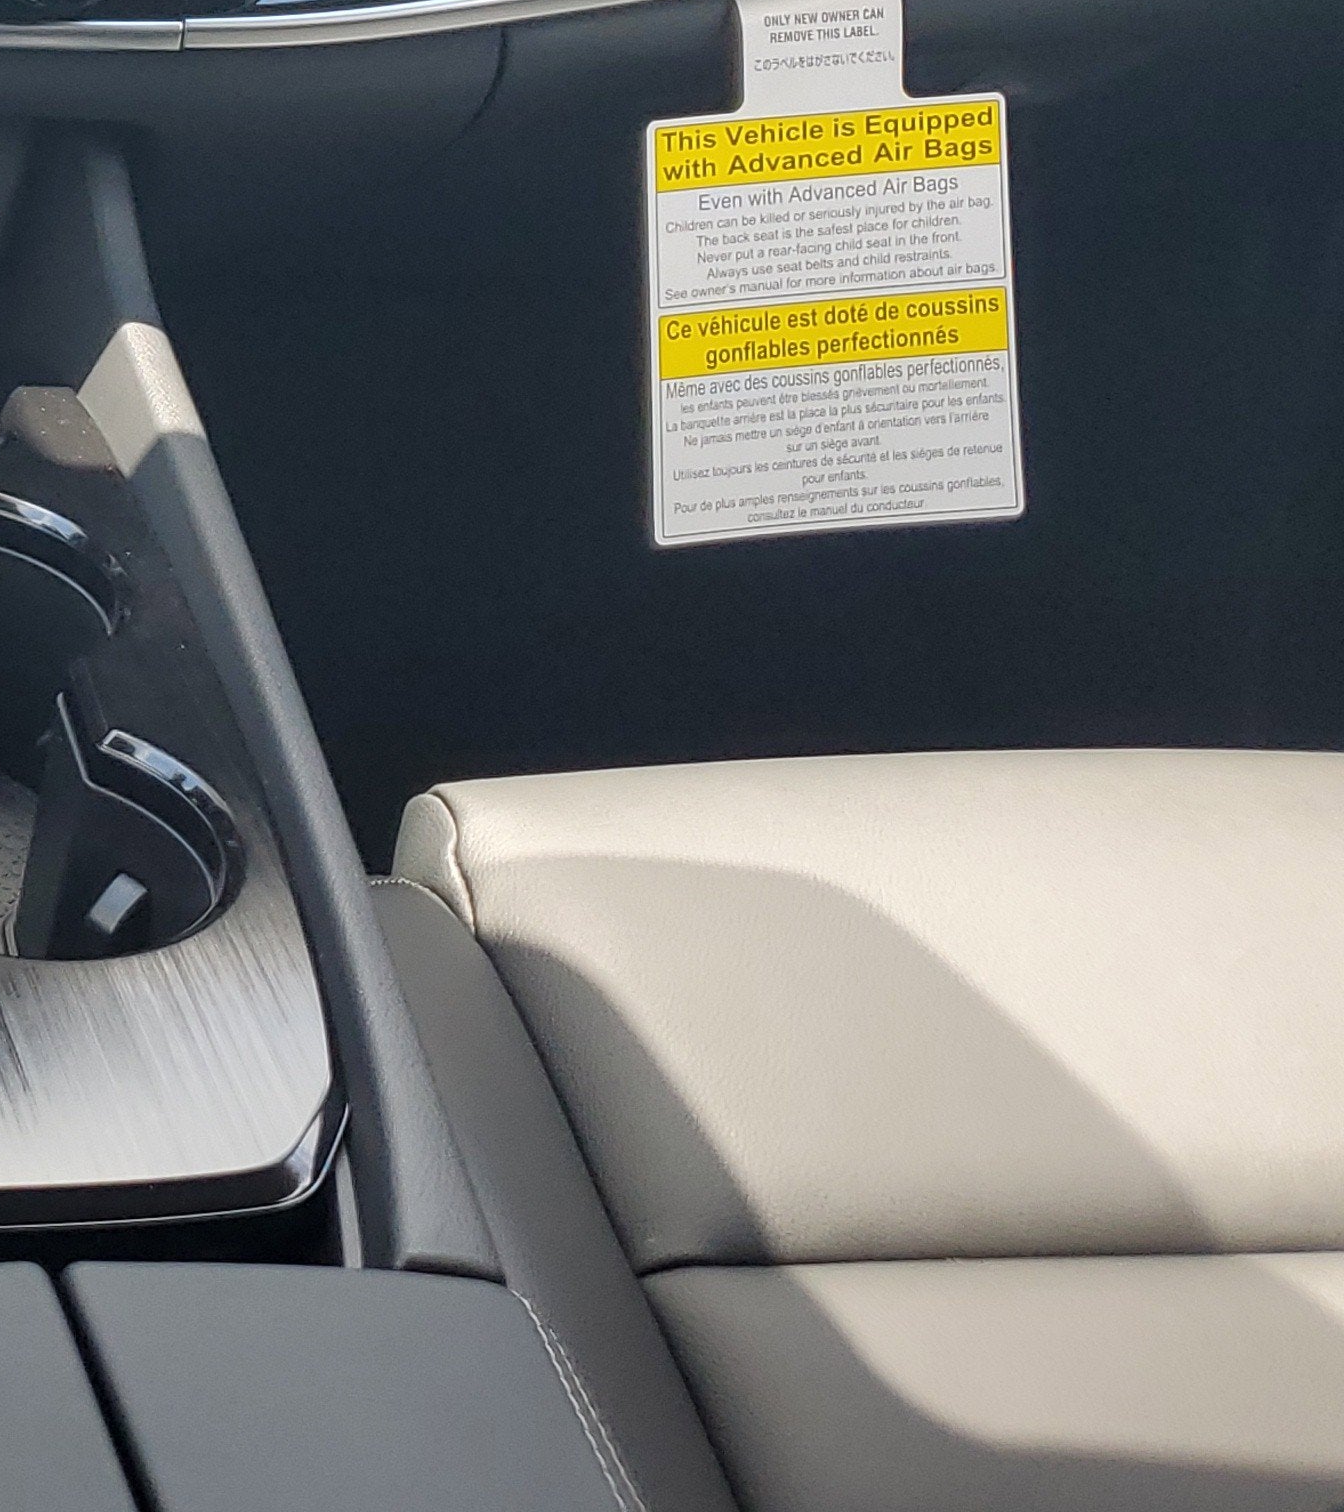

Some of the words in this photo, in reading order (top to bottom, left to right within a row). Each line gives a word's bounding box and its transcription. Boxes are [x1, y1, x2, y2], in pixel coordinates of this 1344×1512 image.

[764, 14, 791, 28] ONLY
[794, 12, 818, 25] NEW
[821, 8, 860, 24] OWNER
[863, 7, 884, 20] CAN
[770, 30, 815, 44] REMOVE
[817, 27, 840, 40] THIS
[844, 25, 879, 38] LABEL.
[662, 129, 717, 152] This
[725, 120, 824, 147] Vehicle
[833, 117, 855, 138] is
[865, 105, 993, 138] Equipped
[662, 157, 716, 181] with
[728, 144, 862, 176] Advanced
[873, 141, 913, 163] Air
[924, 138, 993, 161] Bags
[698, 193, 742, 211] Even
[748, 189, 782, 205] with
[788, 180, 877, 204] Advanced
[883, 176, 908, 194] Air
[913, 175, 959, 195] Bags
[665, 219, 713, 234] Children
[716, 217, 738, 229] can
[742, 215, 756, 227] be
[760, 211, 790, 225] killed
[793, 212, 805, 222] or
[809, 205, 861, 221] seriously
[865, 202, 905, 217] injured
[908, 200, 923, 214] by
[927, 199, 946, 211] the
[949, 198, 964, 209] air
[967, 196, 994, 209] bag.
[696, 234, 719, 248] The
[722, 232, 750, 245] back
[754, 228, 779, 241] seat
[782, 226, 792, 238] is
[795, 226, 815, 238] the
[818, 222, 853, 236] safest
[856, 220, 889, 235] place
[892, 218, 908, 231] for
[697, 251, 733, 264] Never
[736, 249, 754, 262] put
[757, 249, 765, 259] a
[768, 242, 832, 257] rear-facing
[835, 239, 863, 252] child
[866, 236, 891, 249] seat
[895, 235, 906, 246] in
[909, 233, 928, 245] the
[666, 320, 692, 341] Ce
[698, 310, 781, 337] véhicule
[787, 308, 817, 328] est
[824, 302, 868, 326] doté
[874, 301, 900, 321] de
[906, 294, 1000, 319] coussins
[706, 338, 811, 370] gonflables
[816, 324, 959, 360] perfectionnés
[666, 380, 706, 399] Même
[709, 379, 741, 394] avec
[744, 374, 768, 390] des
[771, 368, 829, 388] coussins
[833, 363, 904, 387] gonflables
[906, 355, 1005, 381] perfectionnés,
